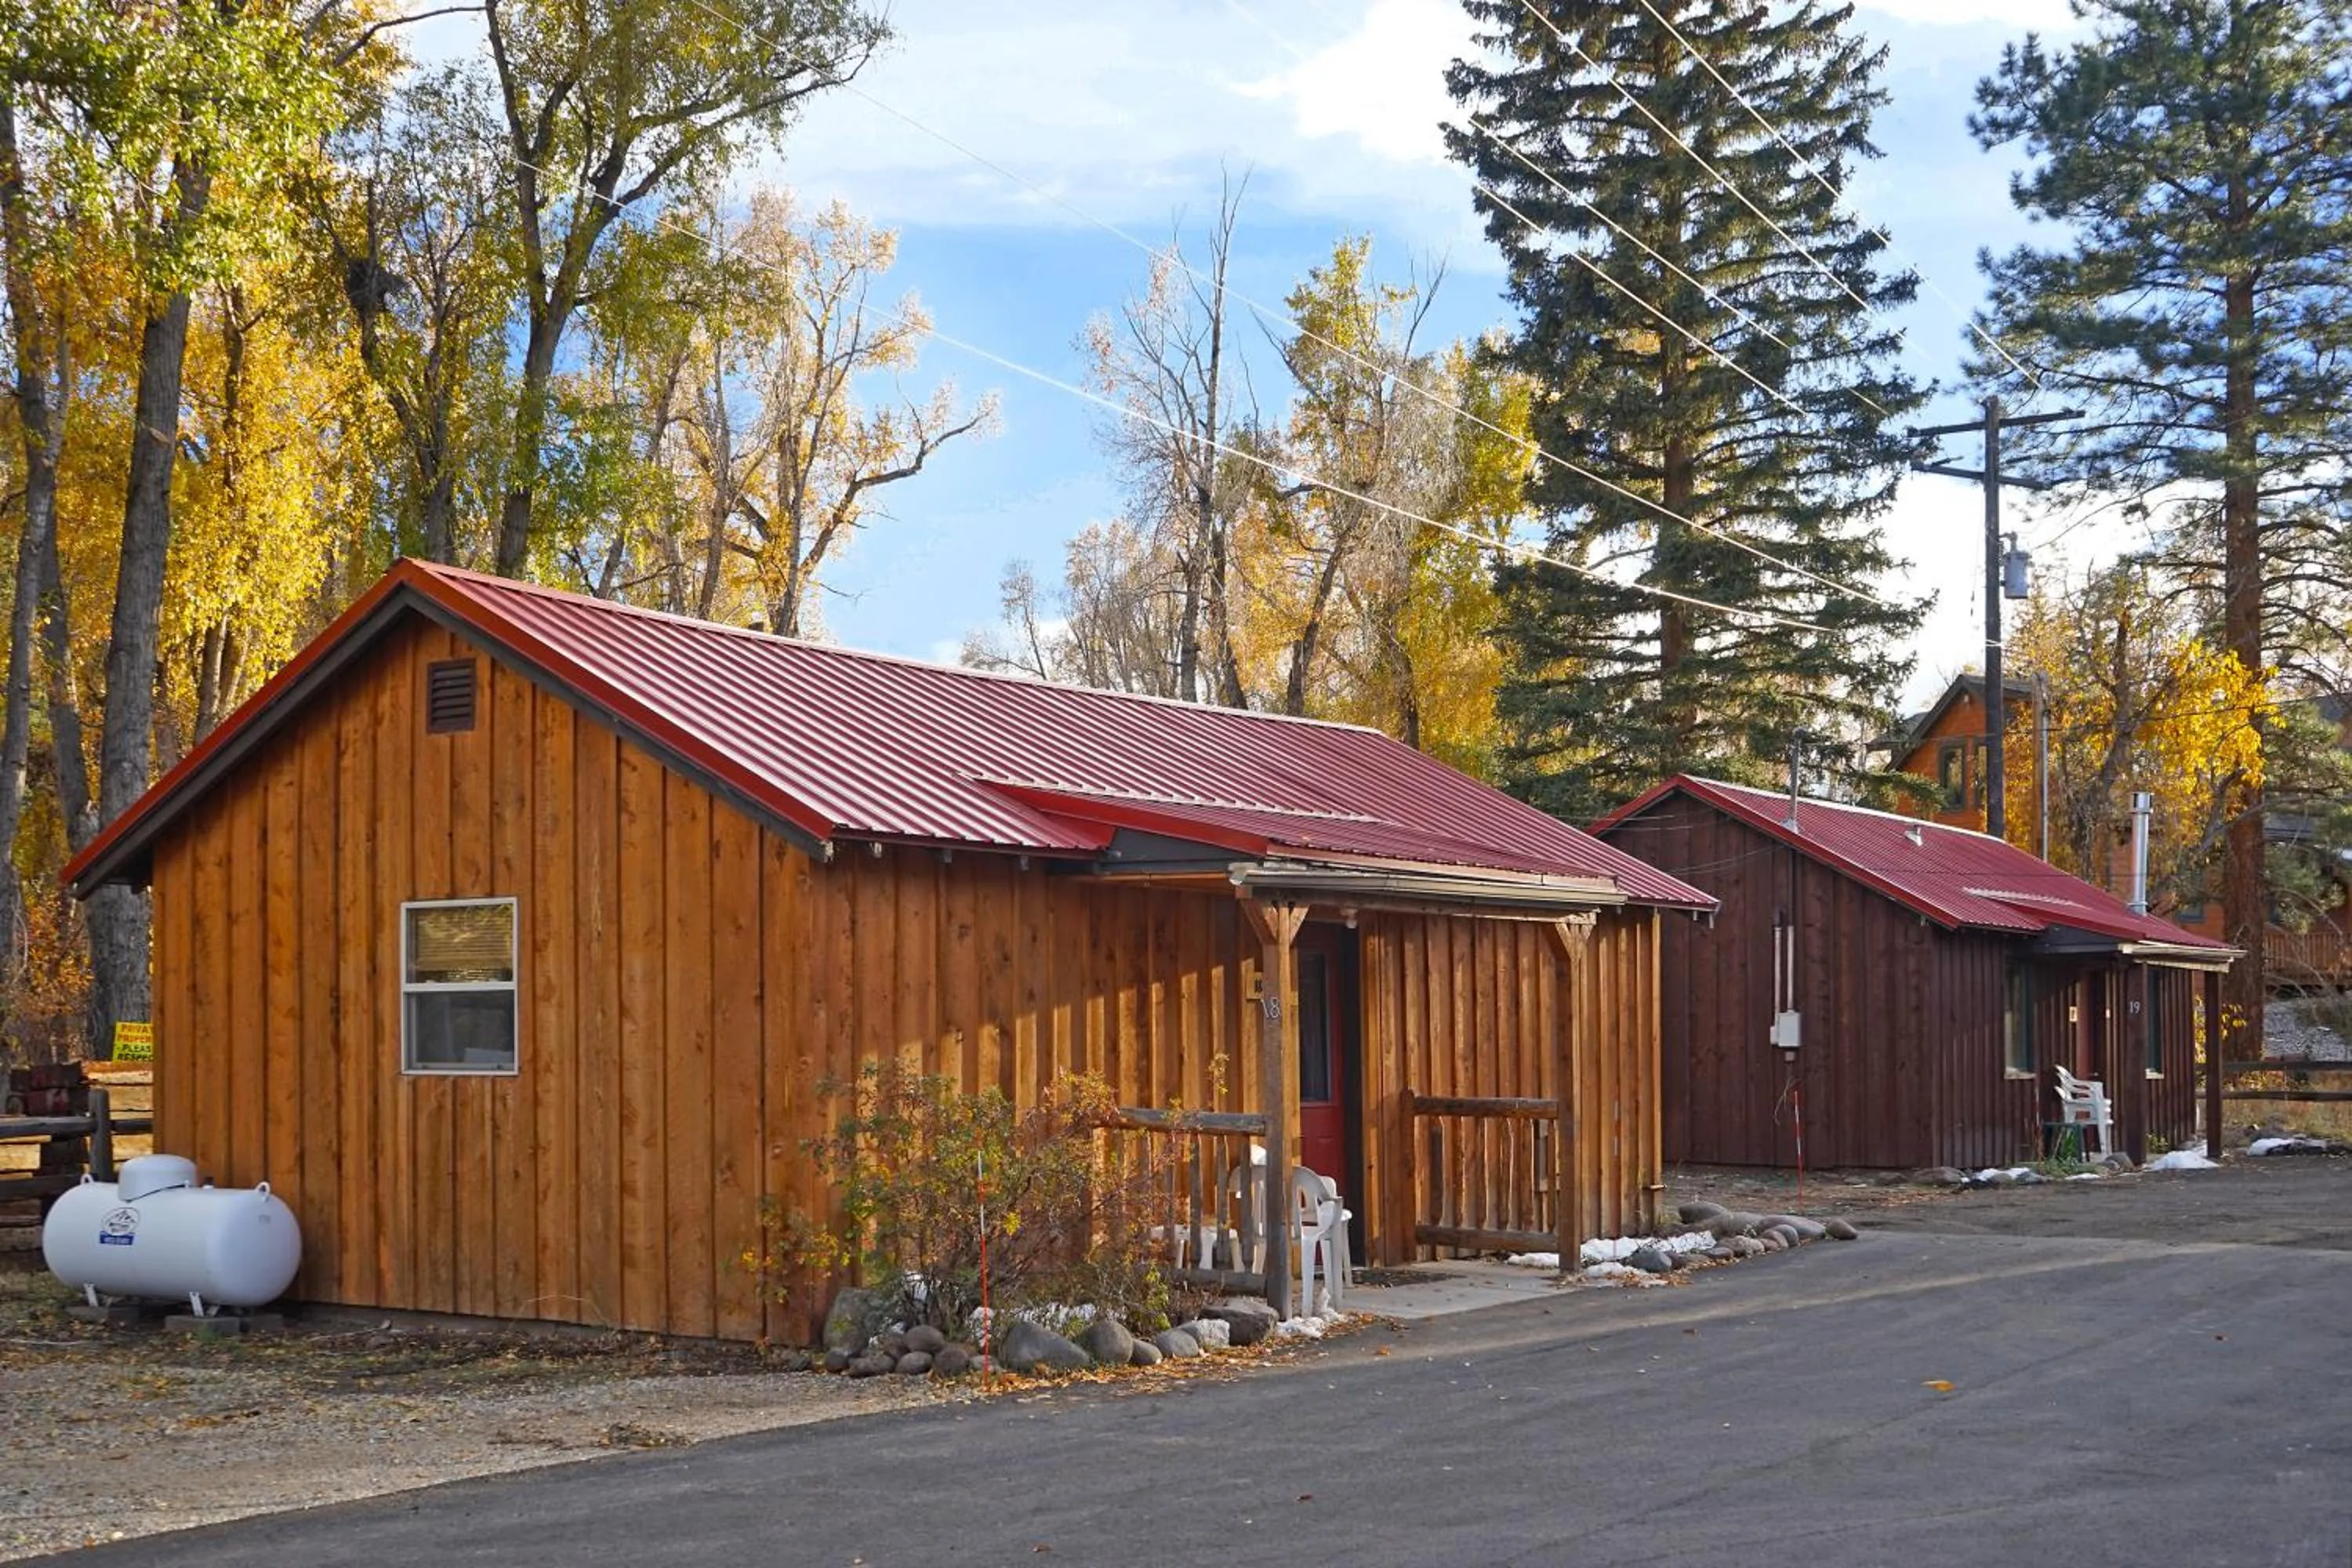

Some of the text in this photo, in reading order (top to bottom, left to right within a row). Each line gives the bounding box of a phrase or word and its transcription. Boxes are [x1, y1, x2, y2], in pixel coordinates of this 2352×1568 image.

[1261, 996, 1280, 1018] 18
[2129, 1000, 2141, 1014] 19
[122, 1024, 151, 1033] PRIVA
[122, 1044, 151, 1053] PLEAS
